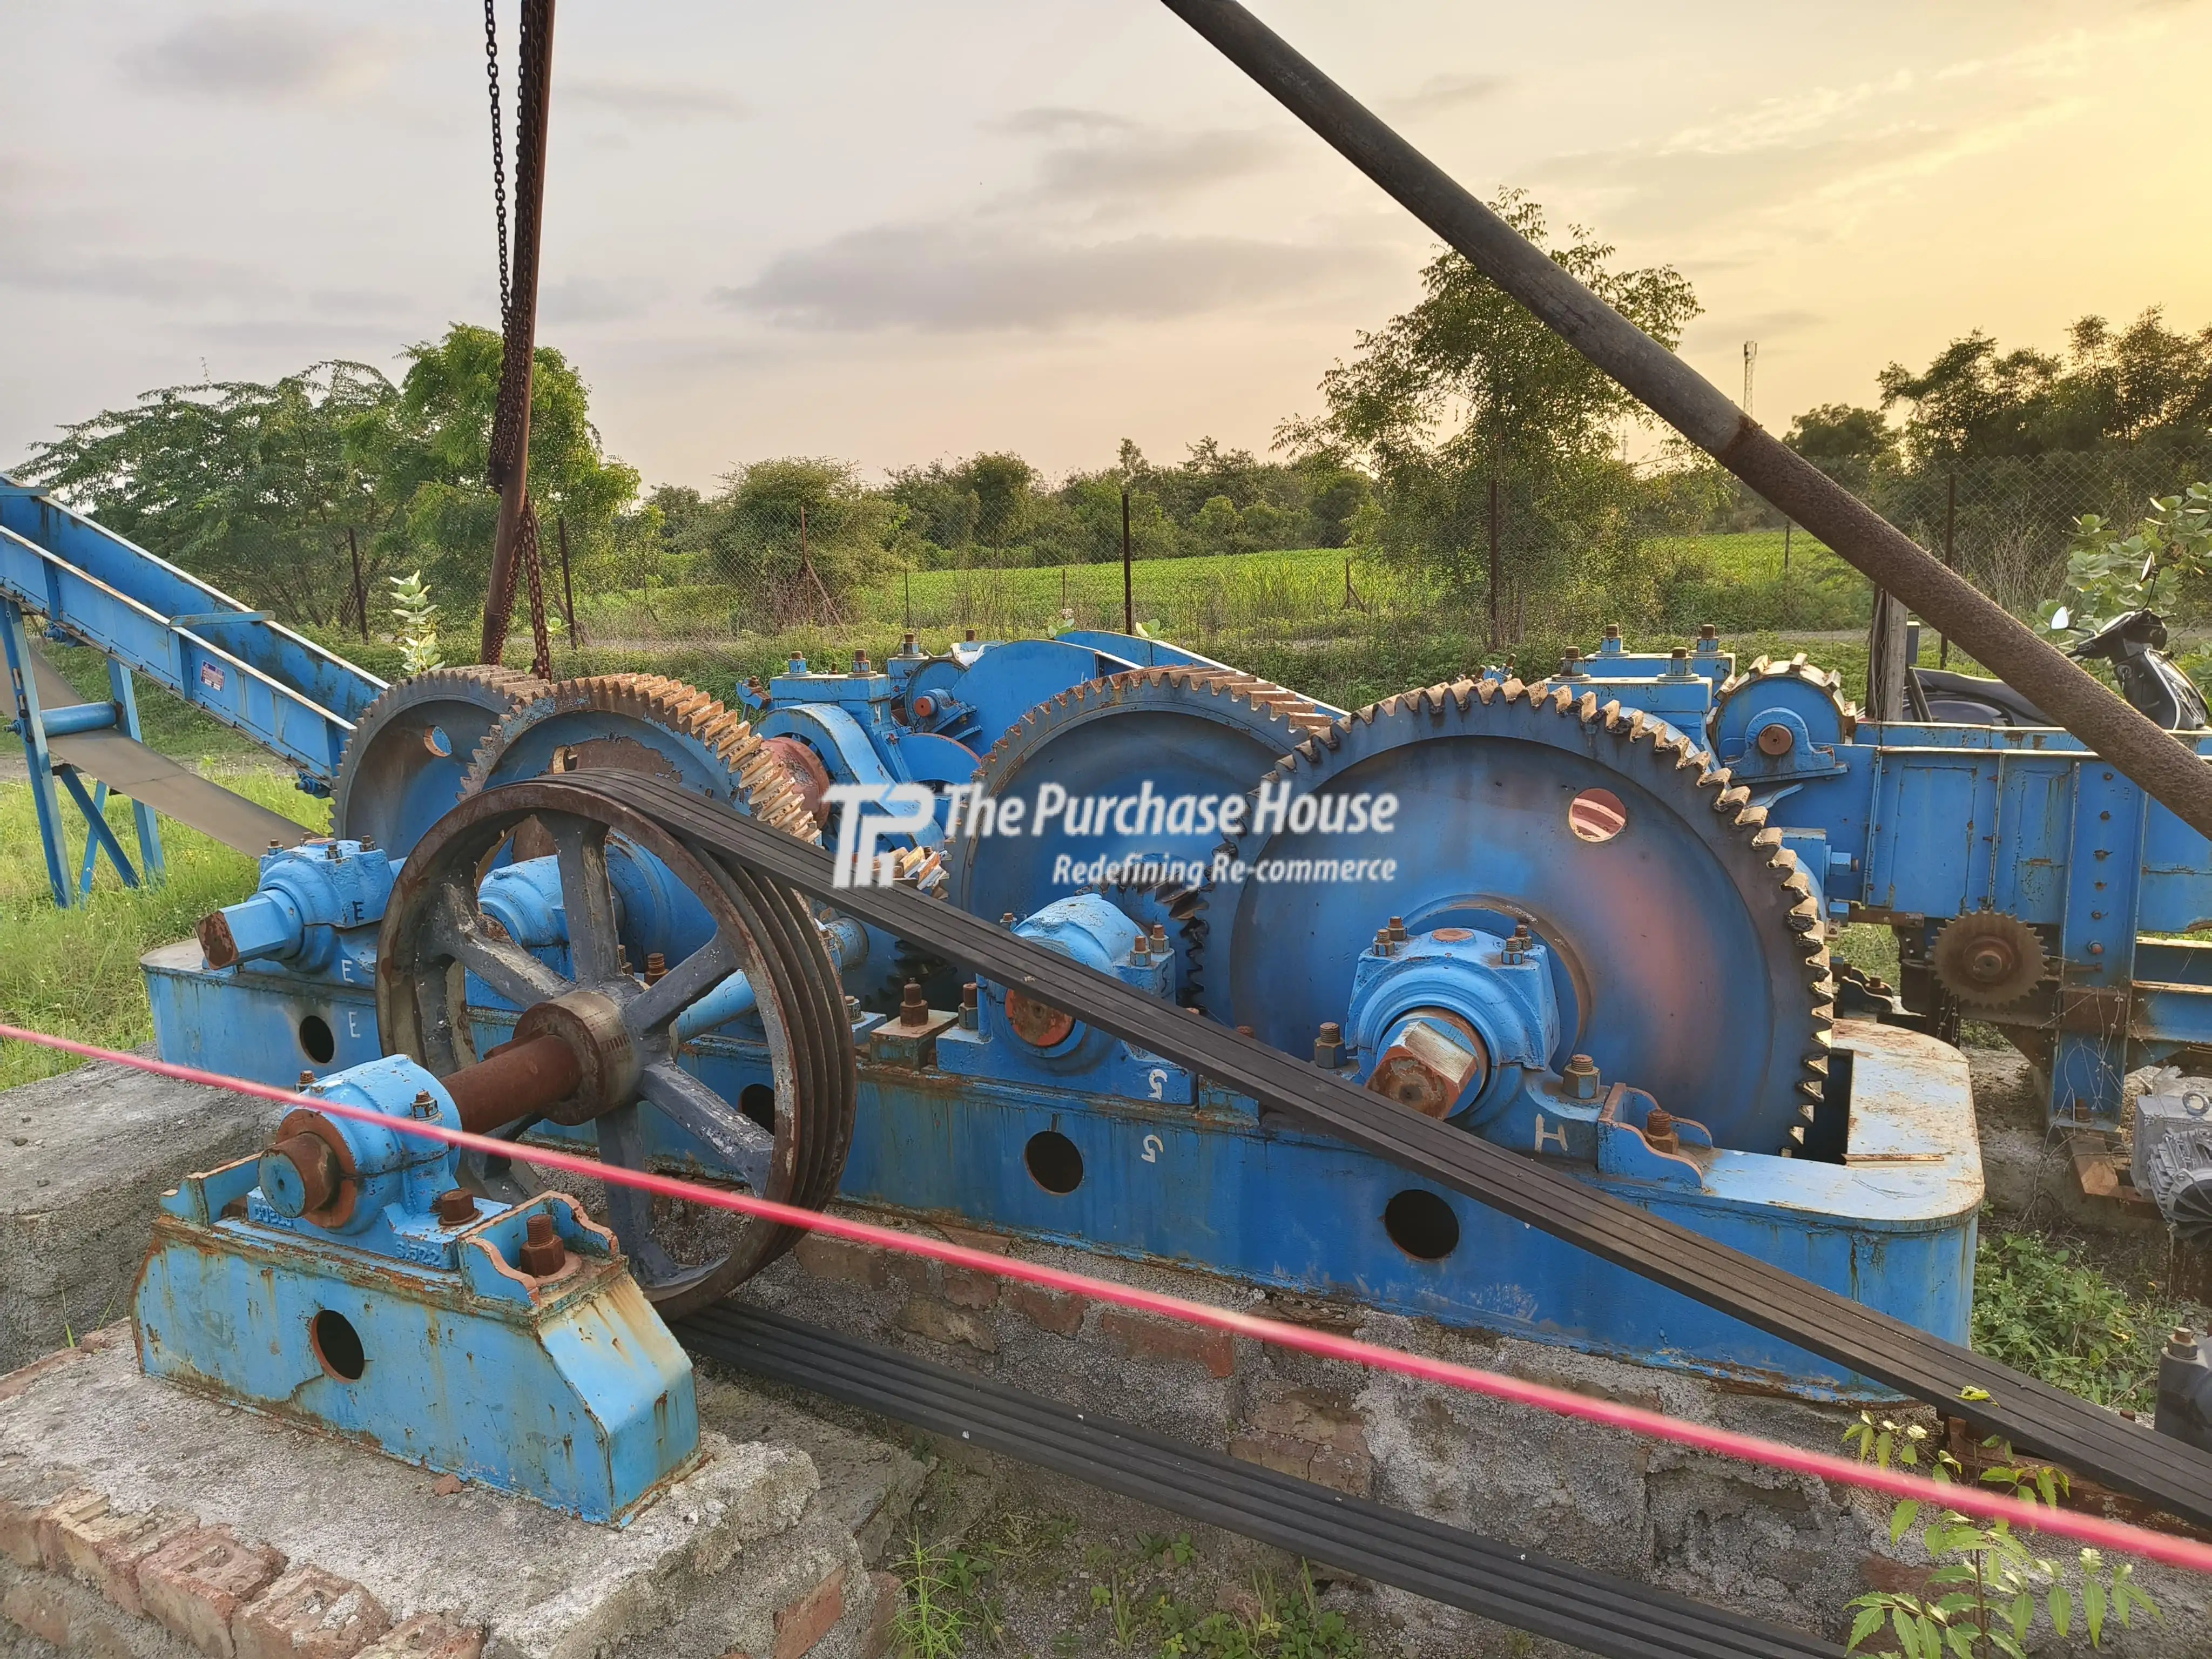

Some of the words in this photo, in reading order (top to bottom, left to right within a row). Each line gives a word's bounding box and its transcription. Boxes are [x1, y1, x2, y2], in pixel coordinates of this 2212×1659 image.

[352, 900, 365, 924] E
[341, 959, 354, 983] E
[348, 1011, 361, 1038] E
[1535, 1114, 1569, 1154] H
